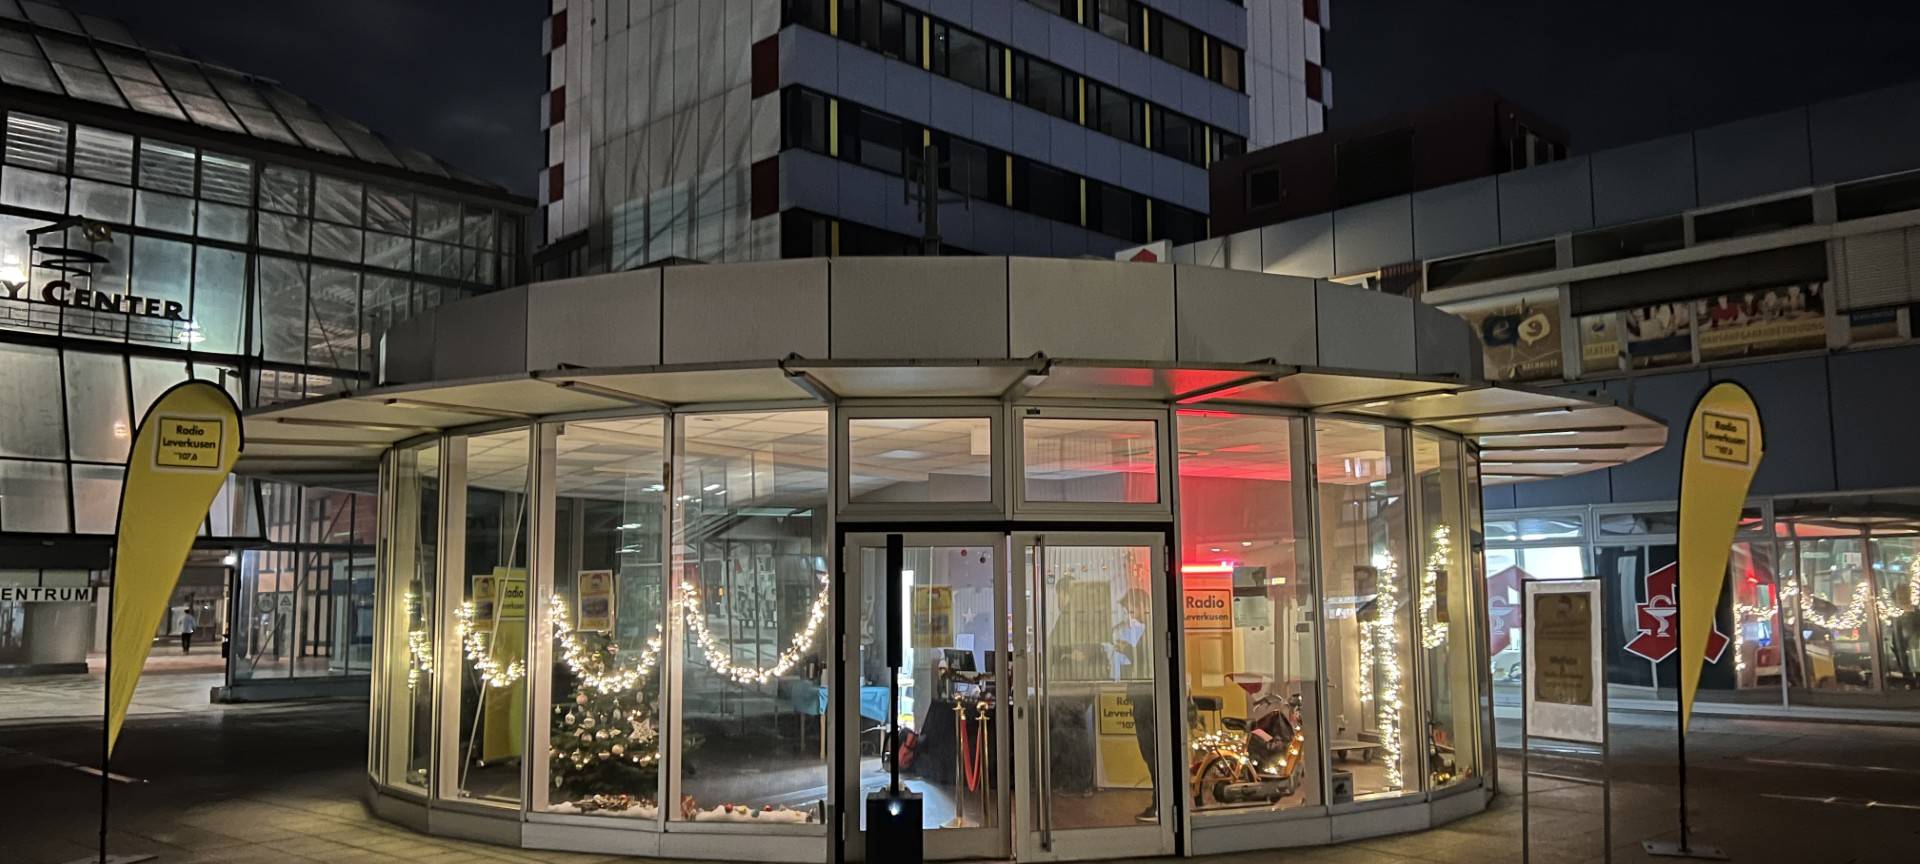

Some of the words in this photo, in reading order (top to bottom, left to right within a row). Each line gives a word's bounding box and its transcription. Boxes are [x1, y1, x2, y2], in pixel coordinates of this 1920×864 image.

[42, 279, 186, 320] CENTER
[176, 424, 205, 436] Radio
[1715, 420, 1738, 433] Radio
[163, 437, 216, 449] Leverkusen
[1, 587, 89, 601] ENTRUM
[504, 585, 524, 598] adio
[1186, 594, 1225, 609] Radio
[1184, 612, 1229, 621] everkusen
